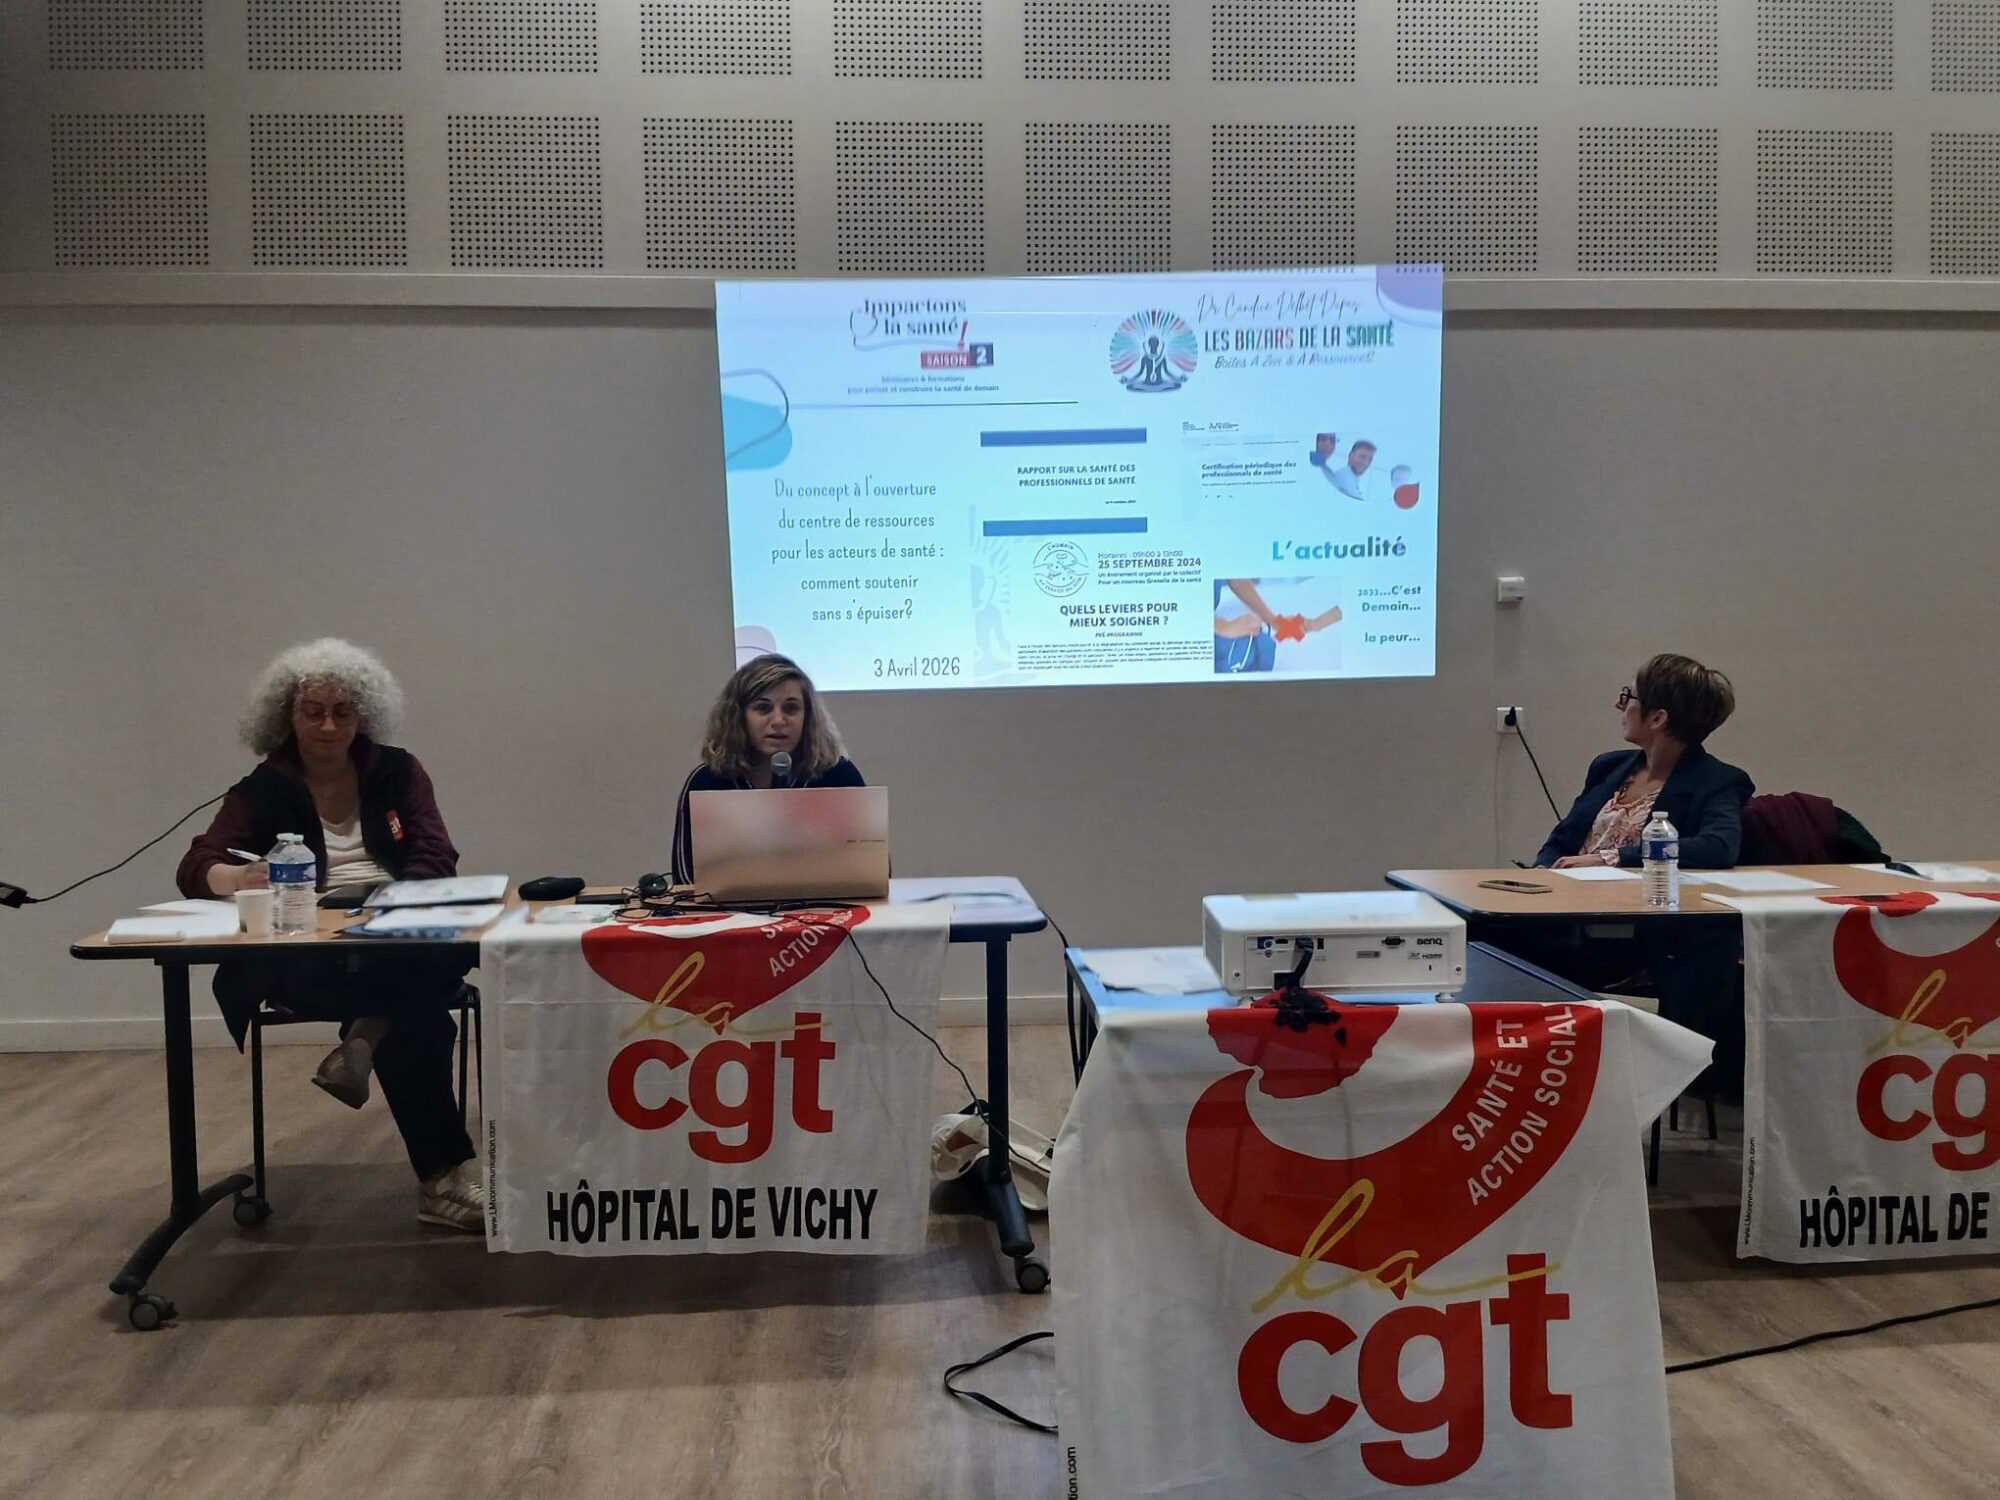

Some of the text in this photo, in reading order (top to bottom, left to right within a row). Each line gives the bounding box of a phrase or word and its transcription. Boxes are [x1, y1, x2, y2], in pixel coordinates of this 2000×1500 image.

[864, 299, 967, 318] Impactons
[885, 317, 901, 336] la
[1204, 319, 1394, 352] LES BAZARS DE LA SANTÉ
[925, 346, 987, 368] SAISON 2
[1017, 462, 1136, 475] RAPPORT SUR LA SANTÉ DES
[774, 474, 937, 502] Du concept à l'ouverture
[1018, 475, 1136, 488] PROFESSIONNELS DE SANTÉ
[778, 507, 935, 529] du centre de ressources
[771, 548, 801, 565] pour
[805, 538, 824, 559] les
[828, 545, 877, 559] acteurs
[880, 537, 896, 559] de
[900, 543, 936, 558] santé
[1098, 557, 1201, 569] 25 SEPTEMBRE 2024
[801, 574, 919, 590] comment soutenir
[812, 598, 913, 624] sans s'épuiser?
[1060, 602, 1178, 616] QUELS LEVIERS POUR
[1362, 600, 1422, 612] Demain...
[1069, 615, 1169, 628] MIEUX SOIGNER ?
[1365, 632, 1421, 645] la peur...
[874, 656, 961, 678] 3 Avril 2026
[607, 1012, 836, 1164] cgt
[1451, 1018, 1529, 1152] SANTÉ ET
[1466, 1110, 1548, 1206] ACTION
[547, 1179, 879, 1244] HÔPITAL DE VICHY
[1799, 1186, 1990, 1248] HÔPITAL DE
[1238, 1252, 1573, 1486] cgt
